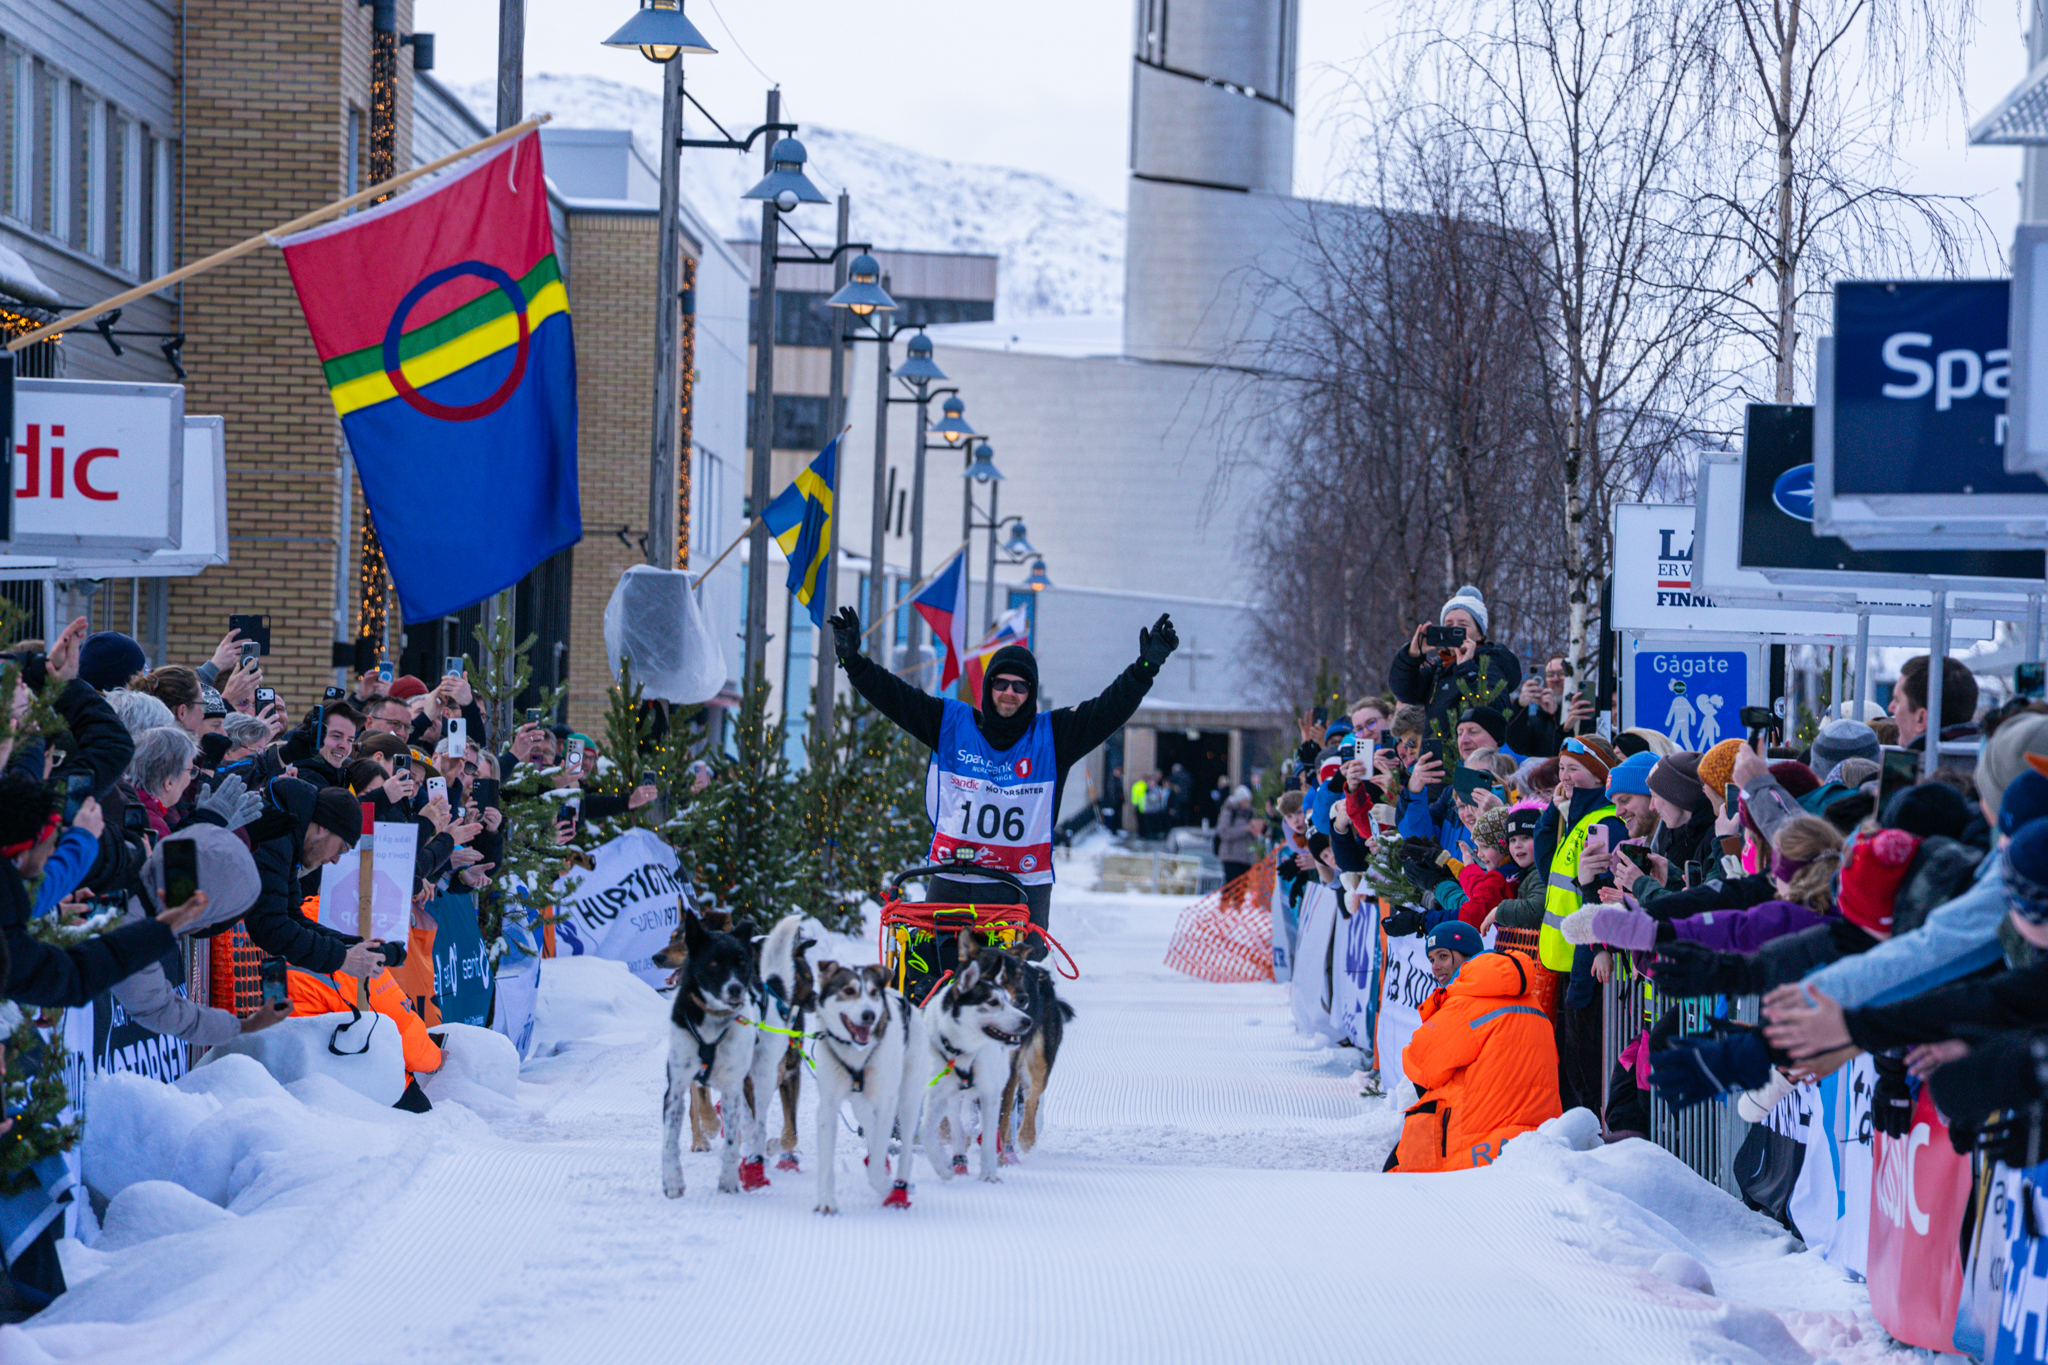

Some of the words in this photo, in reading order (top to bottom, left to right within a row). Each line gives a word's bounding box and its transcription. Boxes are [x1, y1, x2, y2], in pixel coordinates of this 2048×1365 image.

[1657, 564, 1678, 576] ER
[1653, 654, 1729, 677] Gågate
[961, 800, 1025, 841] 106
